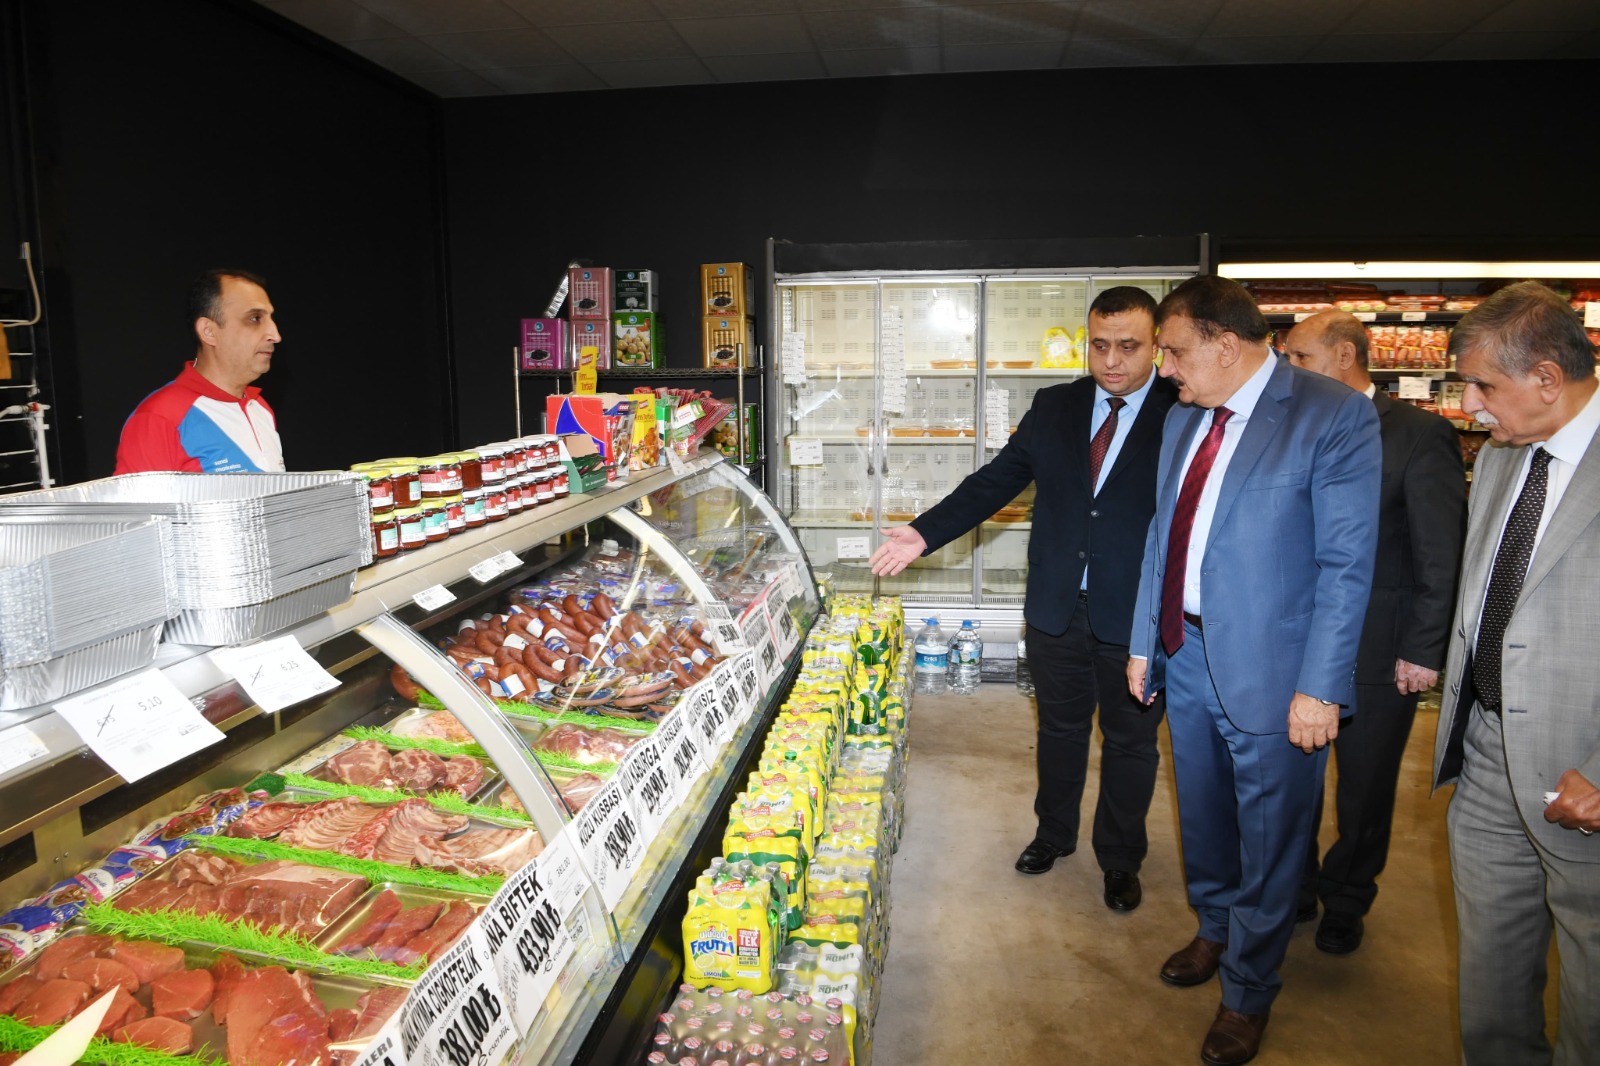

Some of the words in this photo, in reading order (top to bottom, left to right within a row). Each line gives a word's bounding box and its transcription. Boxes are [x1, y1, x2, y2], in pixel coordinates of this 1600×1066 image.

[138, 695, 162, 712] 5,10
[591, 787, 623, 829] KUŞBAŞI
[490, 859, 538, 913] İNDİRİMLERİ
[413, 934, 473, 996] İNDİRİMLERİ
[516, 909, 555, 975] 433,90
[739, 934, 758, 948] TEK
[438, 995, 490, 1066] 381,00
[488, 1024, 511, 1057] esenlik
